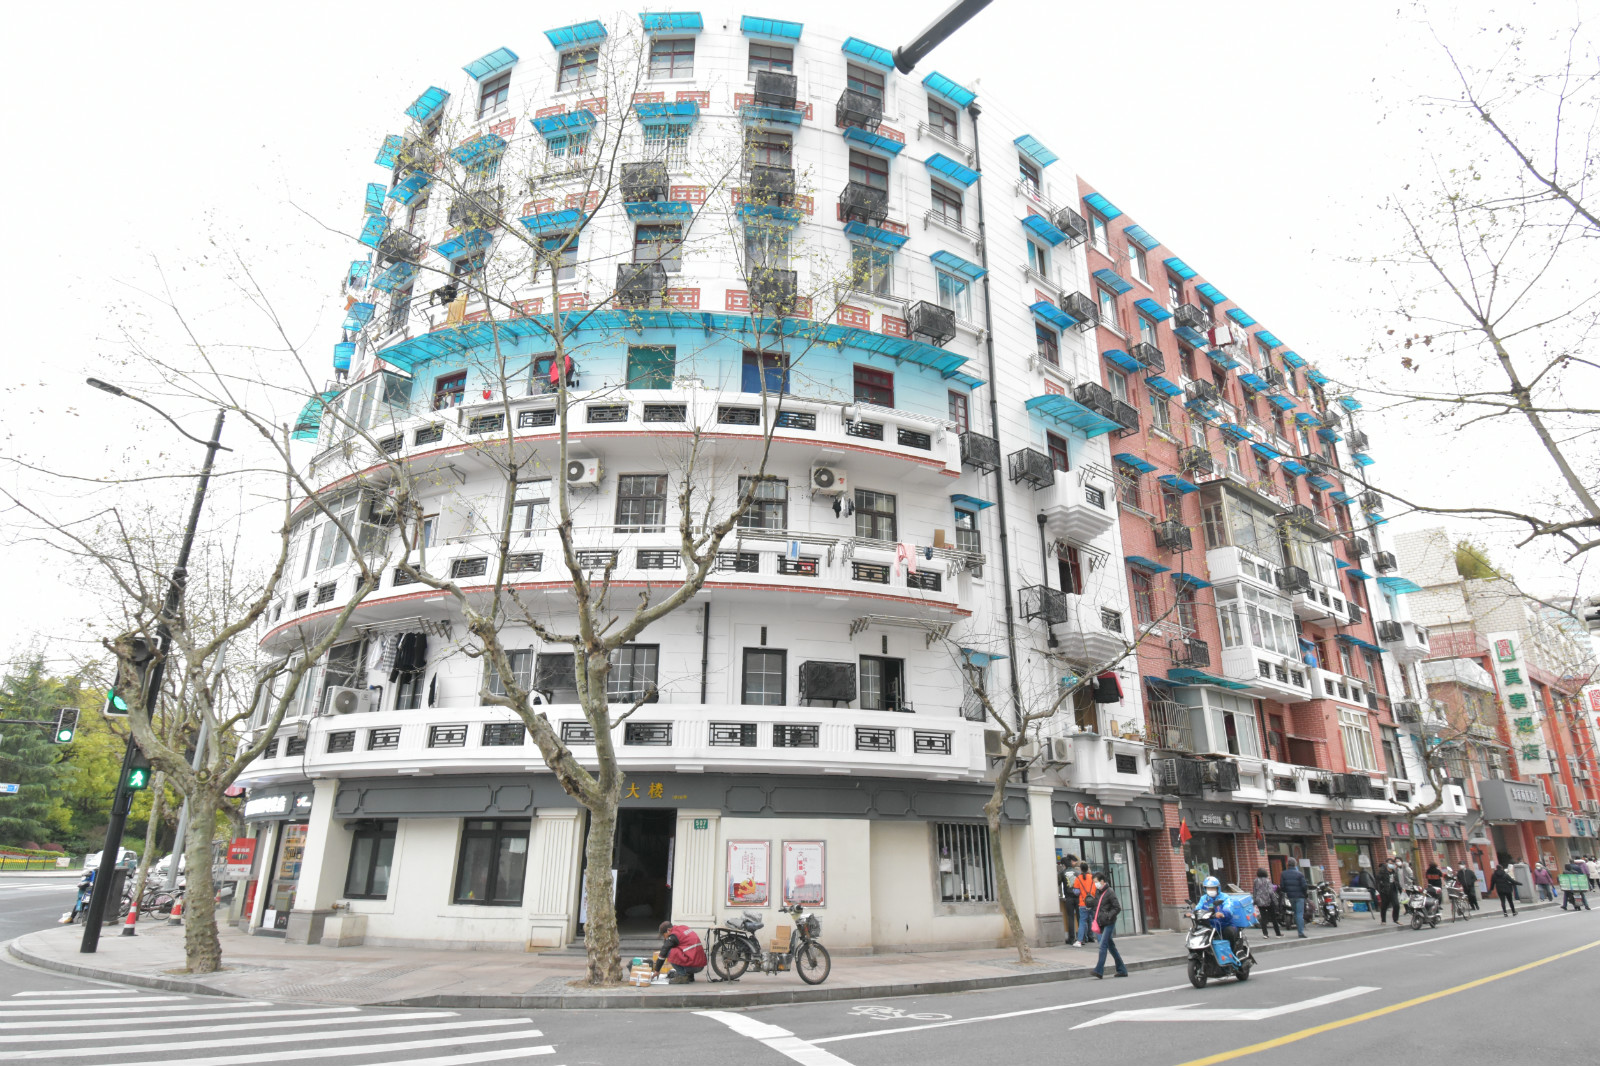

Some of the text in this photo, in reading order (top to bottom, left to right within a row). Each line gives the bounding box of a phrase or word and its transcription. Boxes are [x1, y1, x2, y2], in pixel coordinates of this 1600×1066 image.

[1502, 667, 1540, 760] 莫泰酒店
[624, 782, 664, 799] 大楼
